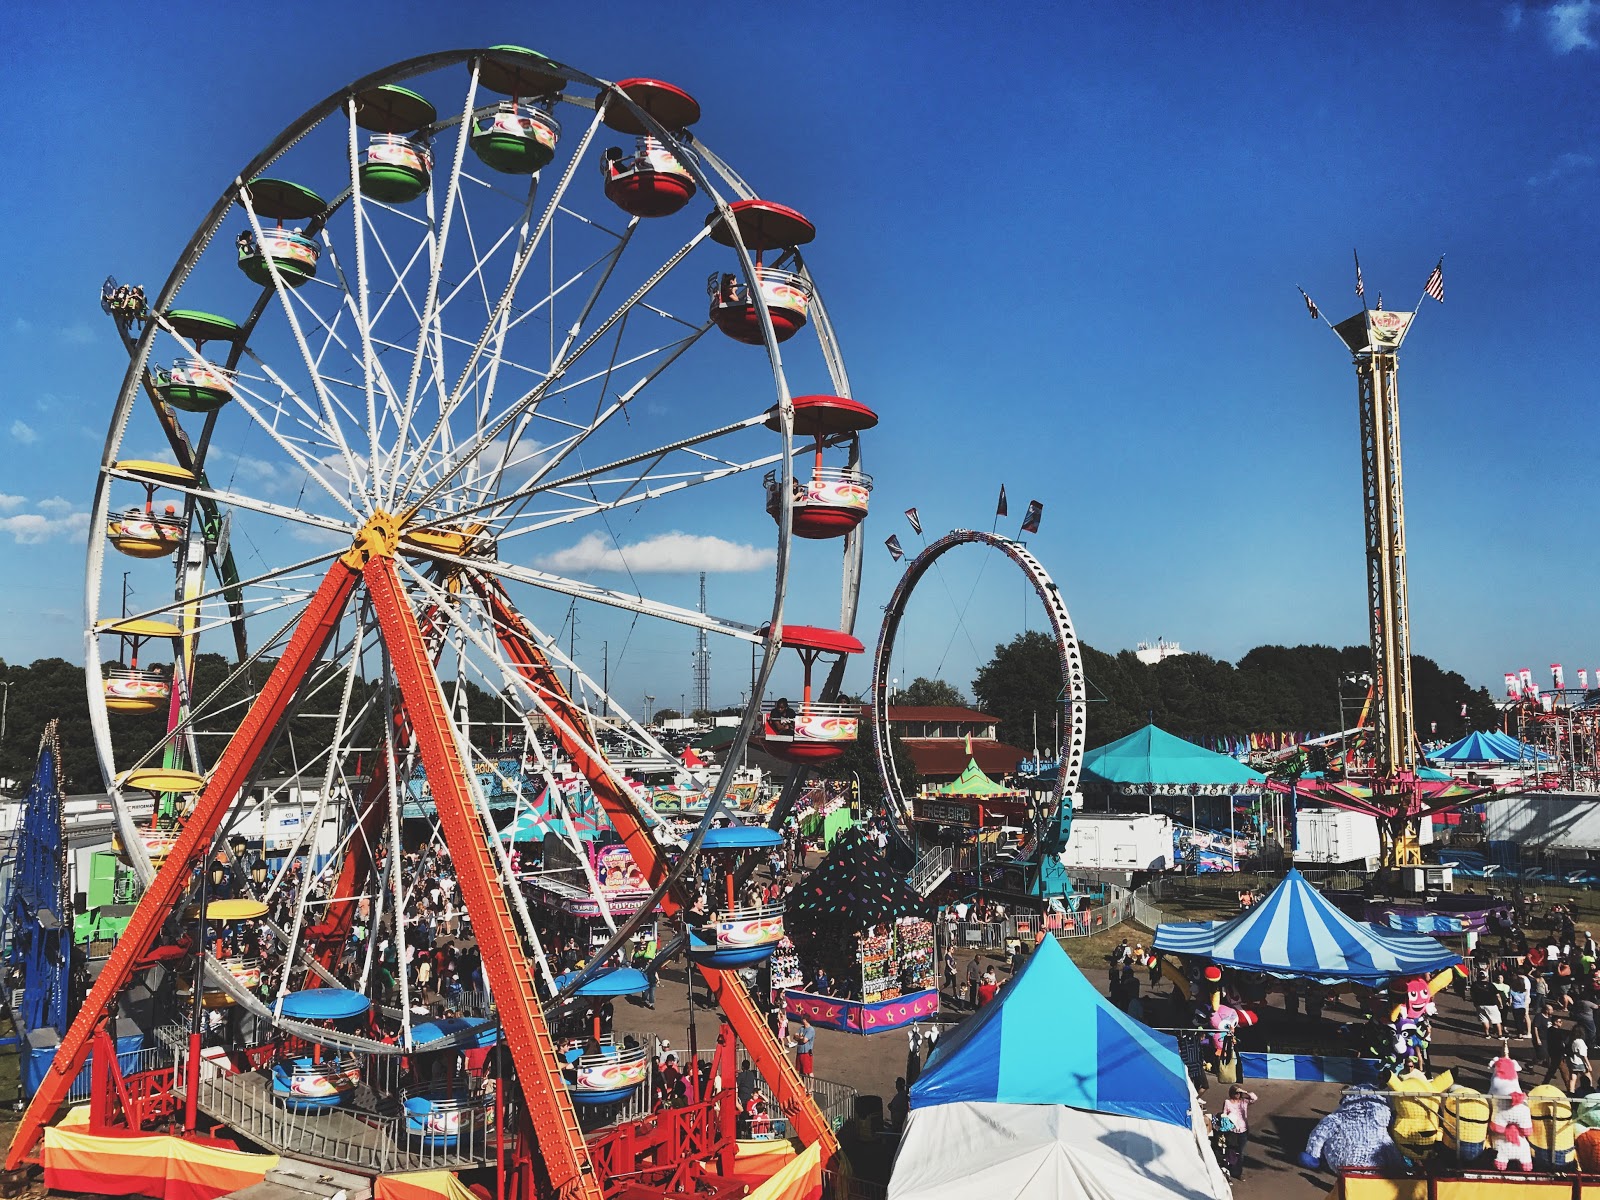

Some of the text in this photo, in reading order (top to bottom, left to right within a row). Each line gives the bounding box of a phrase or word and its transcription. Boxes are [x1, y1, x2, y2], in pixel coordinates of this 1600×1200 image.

[851, 780, 859, 810] ATM
[922, 803, 971, 821] FREE BIRD
[604, 854, 624, 862] CANDY
